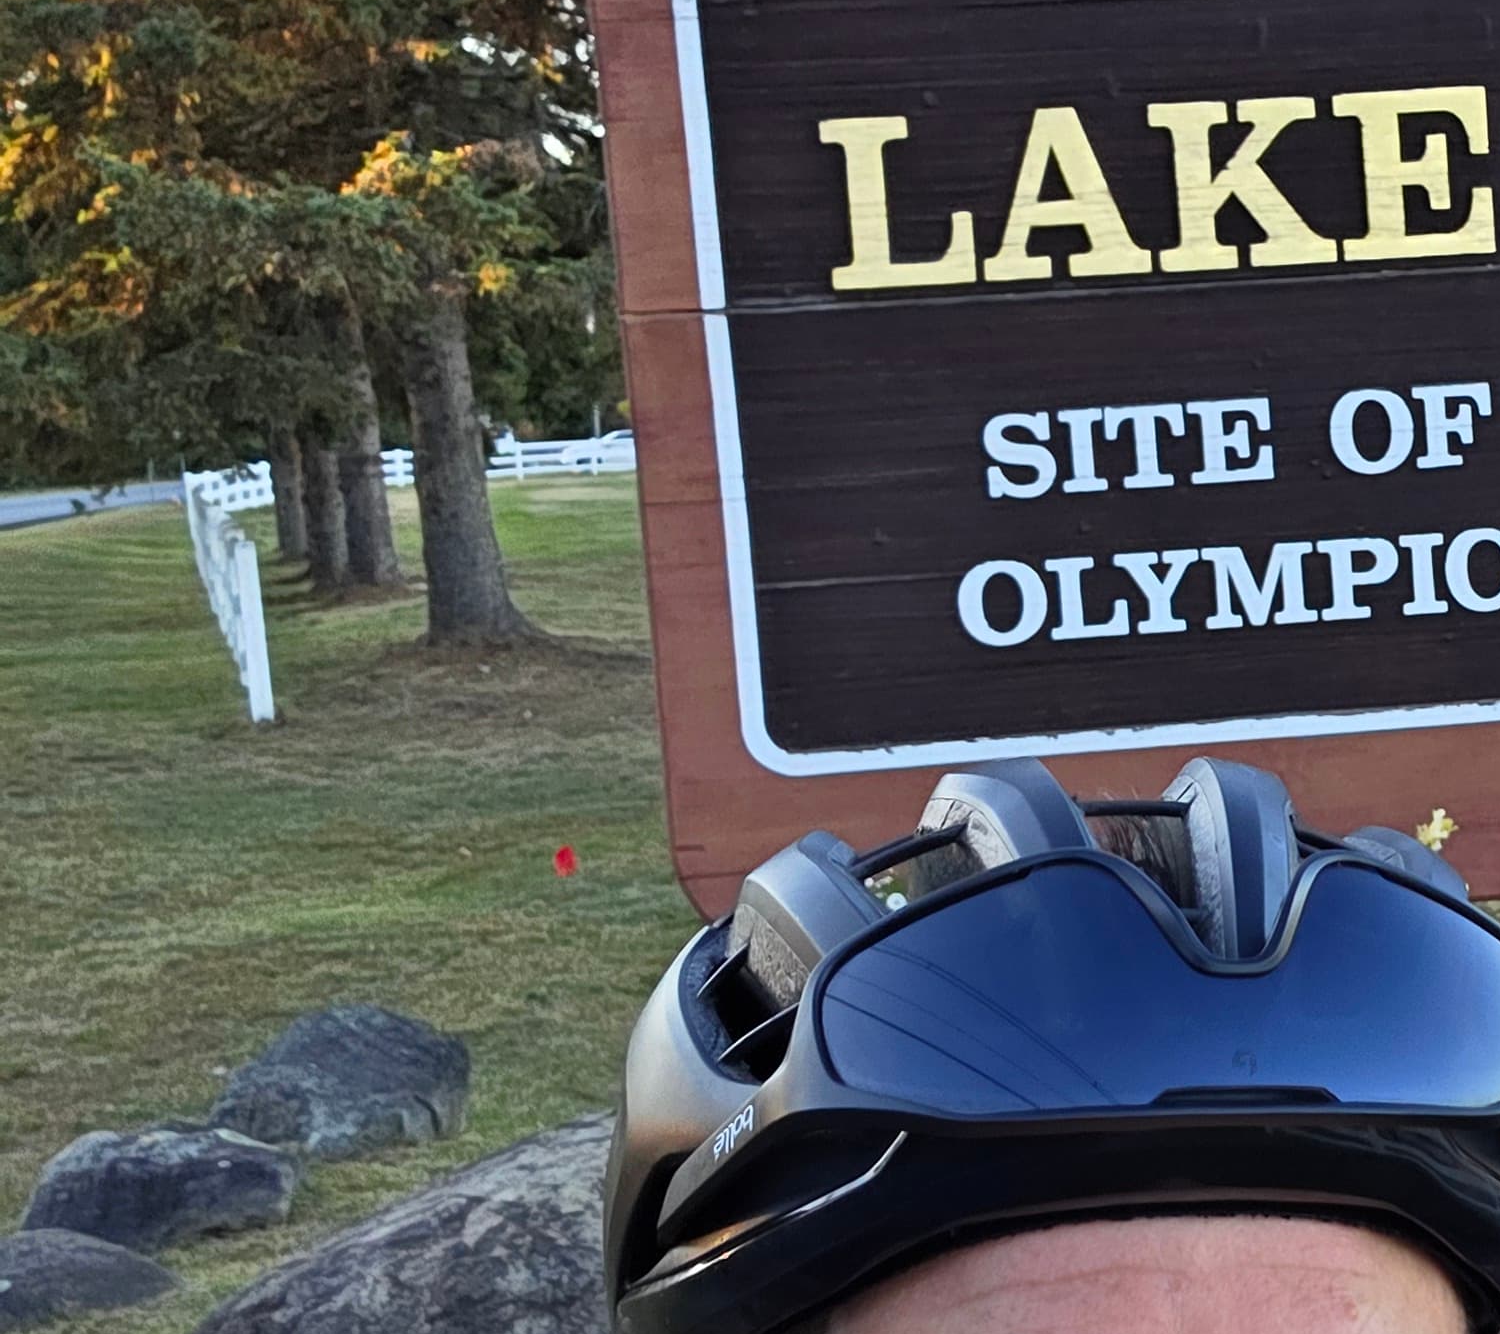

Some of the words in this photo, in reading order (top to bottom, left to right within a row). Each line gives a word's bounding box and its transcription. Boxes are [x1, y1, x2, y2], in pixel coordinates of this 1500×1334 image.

[818, 85, 1497, 290] LAKE
[983, 397, 1275, 499] SITE
[1329, 381, 1492, 475] OF
